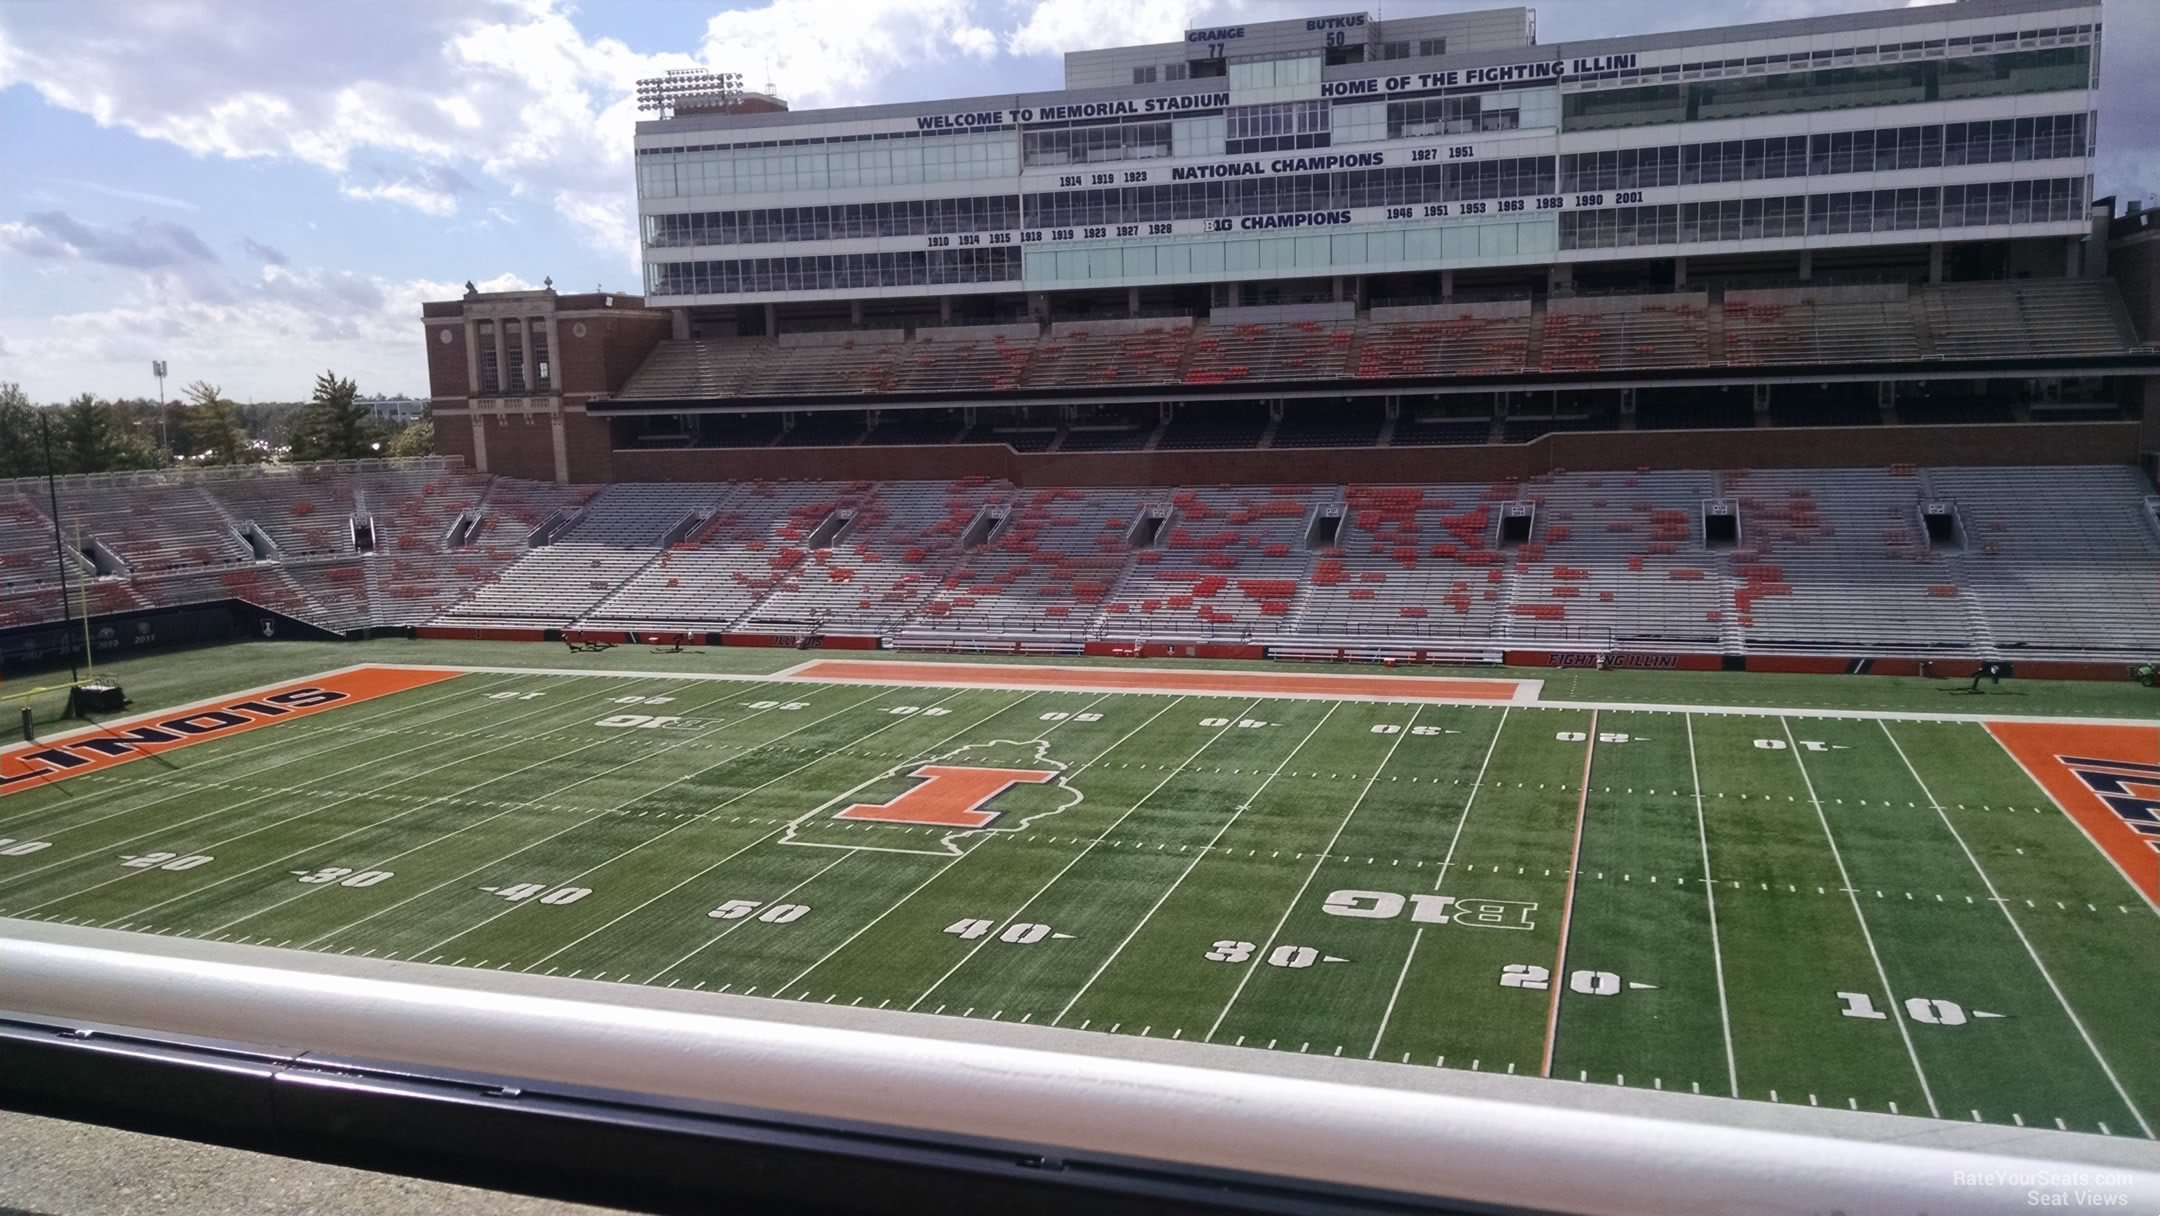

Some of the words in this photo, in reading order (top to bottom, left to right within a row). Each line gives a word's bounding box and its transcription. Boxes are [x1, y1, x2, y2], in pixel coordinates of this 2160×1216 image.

[1306, 15, 1365, 31] BUTKUS
[1188, 28, 1245, 42] GRANGE
[1326, 31, 1345, 47] 50
[1208, 43, 1225, 58] 77
[1321, 80, 1378, 97] HOME
[1385, 76, 1410, 91] OF
[1418, 71, 1458, 87] THE
[1466, 60, 1565, 84] FIGHTING
[1573, 54, 1637, 74] ILLINI
[917, 111, 1003, 130] WELCOME
[1010, 108, 1033, 123] TO
[1039, 100, 1138, 120] MEMORIAL
[1144, 92, 1230, 112] STADIUM
[1060, 175, 1082, 187] 1914
[1092, 173, 1114, 185] 1919
[1124, 171, 1147, 183] 1923
[1172, 161, 1265, 181] NATIONAL
[1271, 152, 1384, 173] CHAMPIONS
[1412, 149, 1438, 161] 1927
[1449, 146, 1474, 158] 1951
[928, 236, 949, 247] 1910
[958, 234, 980, 245] 1914
[989, 233, 1011, 244] 1915
[1020, 231, 1042, 242] 1918
[1052, 229, 1074, 241] 1919
[1083, 227, 1106, 239] 1923
[1116, 225, 1139, 237] 1927
[1148, 223, 1172, 235] 1928
[1241, 210, 1352, 230] CHAMPIONS
[1387, 207, 1413, 219] 1946
[1424, 205, 1449, 217] 1951
[1460, 202, 1486, 215] 1953
[1575, 194, 1603, 207] 1990
[1615, 191, 1644, 204] 2001
[134, 633, 155, 644] 2011
[774, 635, 824, 647] ILLIOIS
[1548, 653, 1625, 666] FIGHTNG
[1628, 655, 1679, 667] ILLINI
[1039, 712, 1104, 722] 50
[1198, 717, 1268, 729] 40
[1370, 724, 1442, 736] 30
[1555, 731, 1629, 743] 20
[1753, 738, 1827, 751] 10
[120, 852, 215, 871] 20
[298, 867, 396, 888] 30
[493, 882, 594, 906] 40
[706, 899, 812, 924] 50
[943, 917, 1051, 945] 40
[1203, 940, 1320, 968] 30
[1499, 963, 1622, 996] 20
[1836, 991, 1969, 1026] 10
